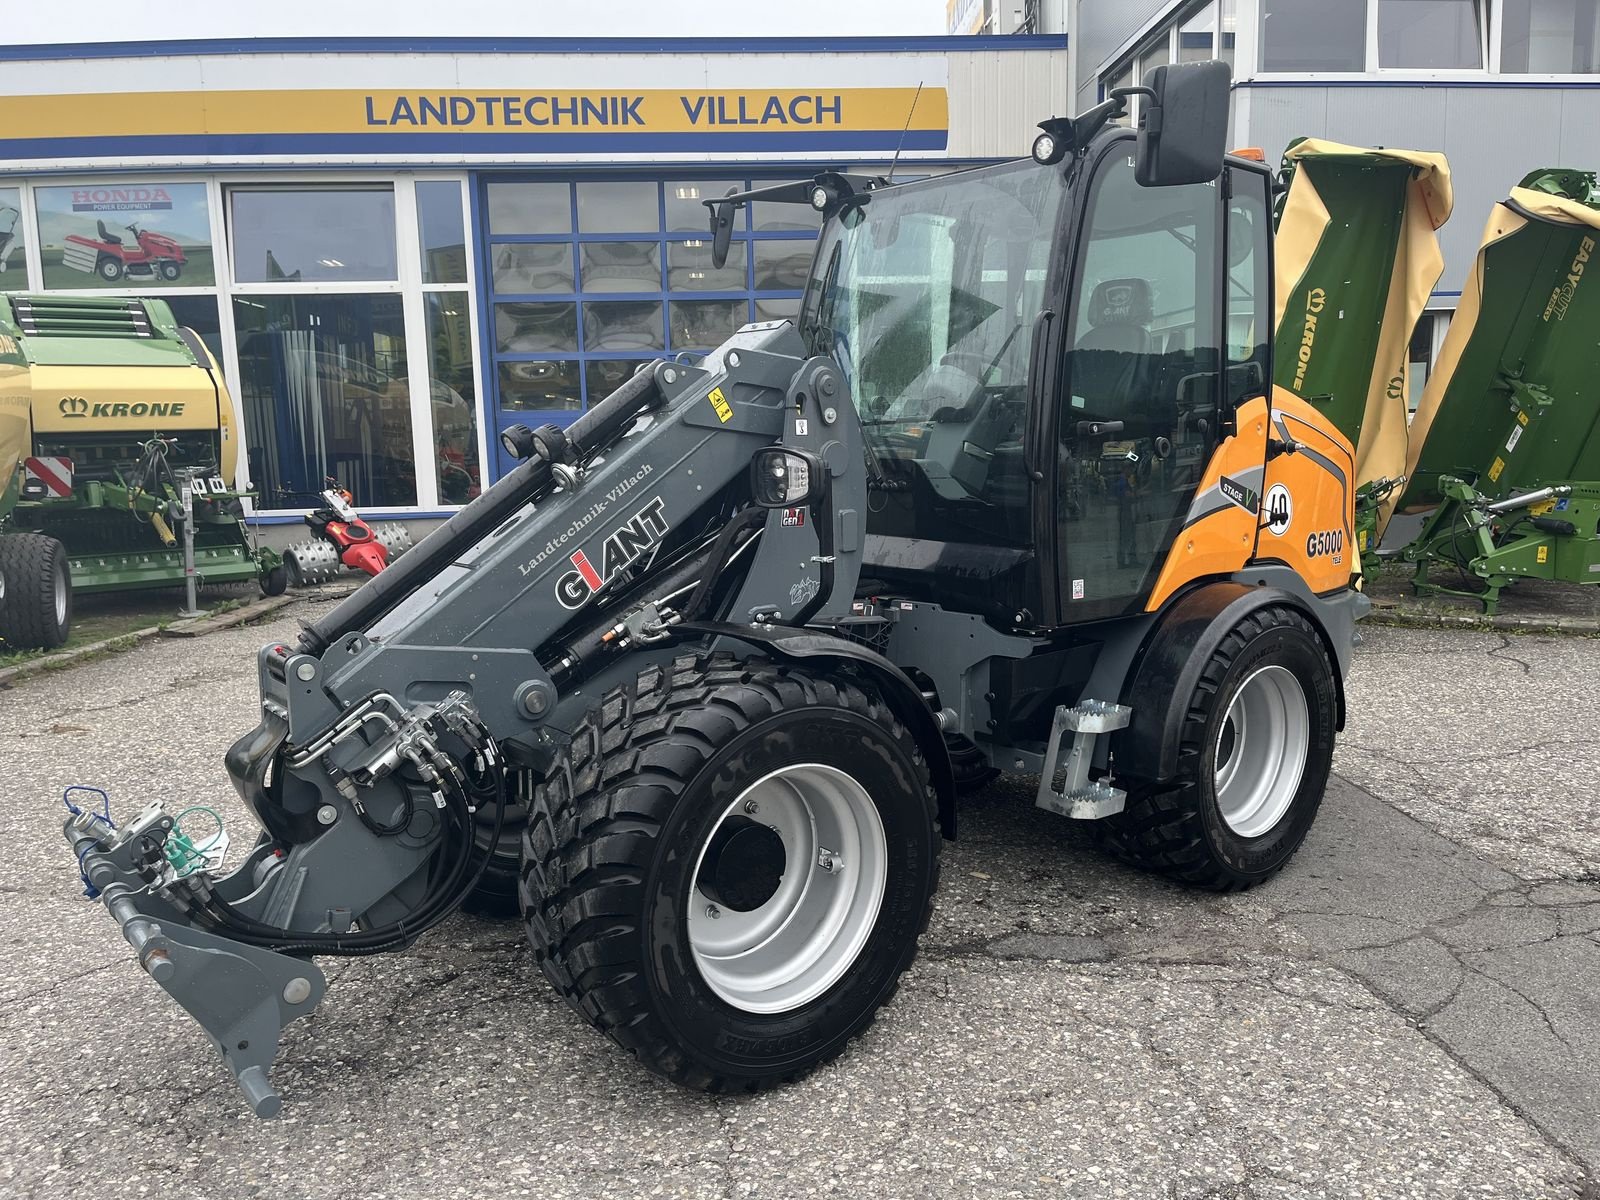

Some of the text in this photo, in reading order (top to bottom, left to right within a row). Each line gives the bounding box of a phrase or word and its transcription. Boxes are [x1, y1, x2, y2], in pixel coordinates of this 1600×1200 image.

[365, 95, 842, 126] LANDTECHNIK VILLACH
[72, 188, 172, 203] HONDA
[93, 202, 152, 211] POWER EQUIPMENT
[1293, 313, 1317, 391] KRONE
[91, 402, 186, 417] KRONE
[1222, 483, 1243, 502] STAGE
[518, 462, 653, 576] Landtechnik-Villach
[1306, 529, 1343, 558] G5000
[1332, 556, 1342, 565] TELE
